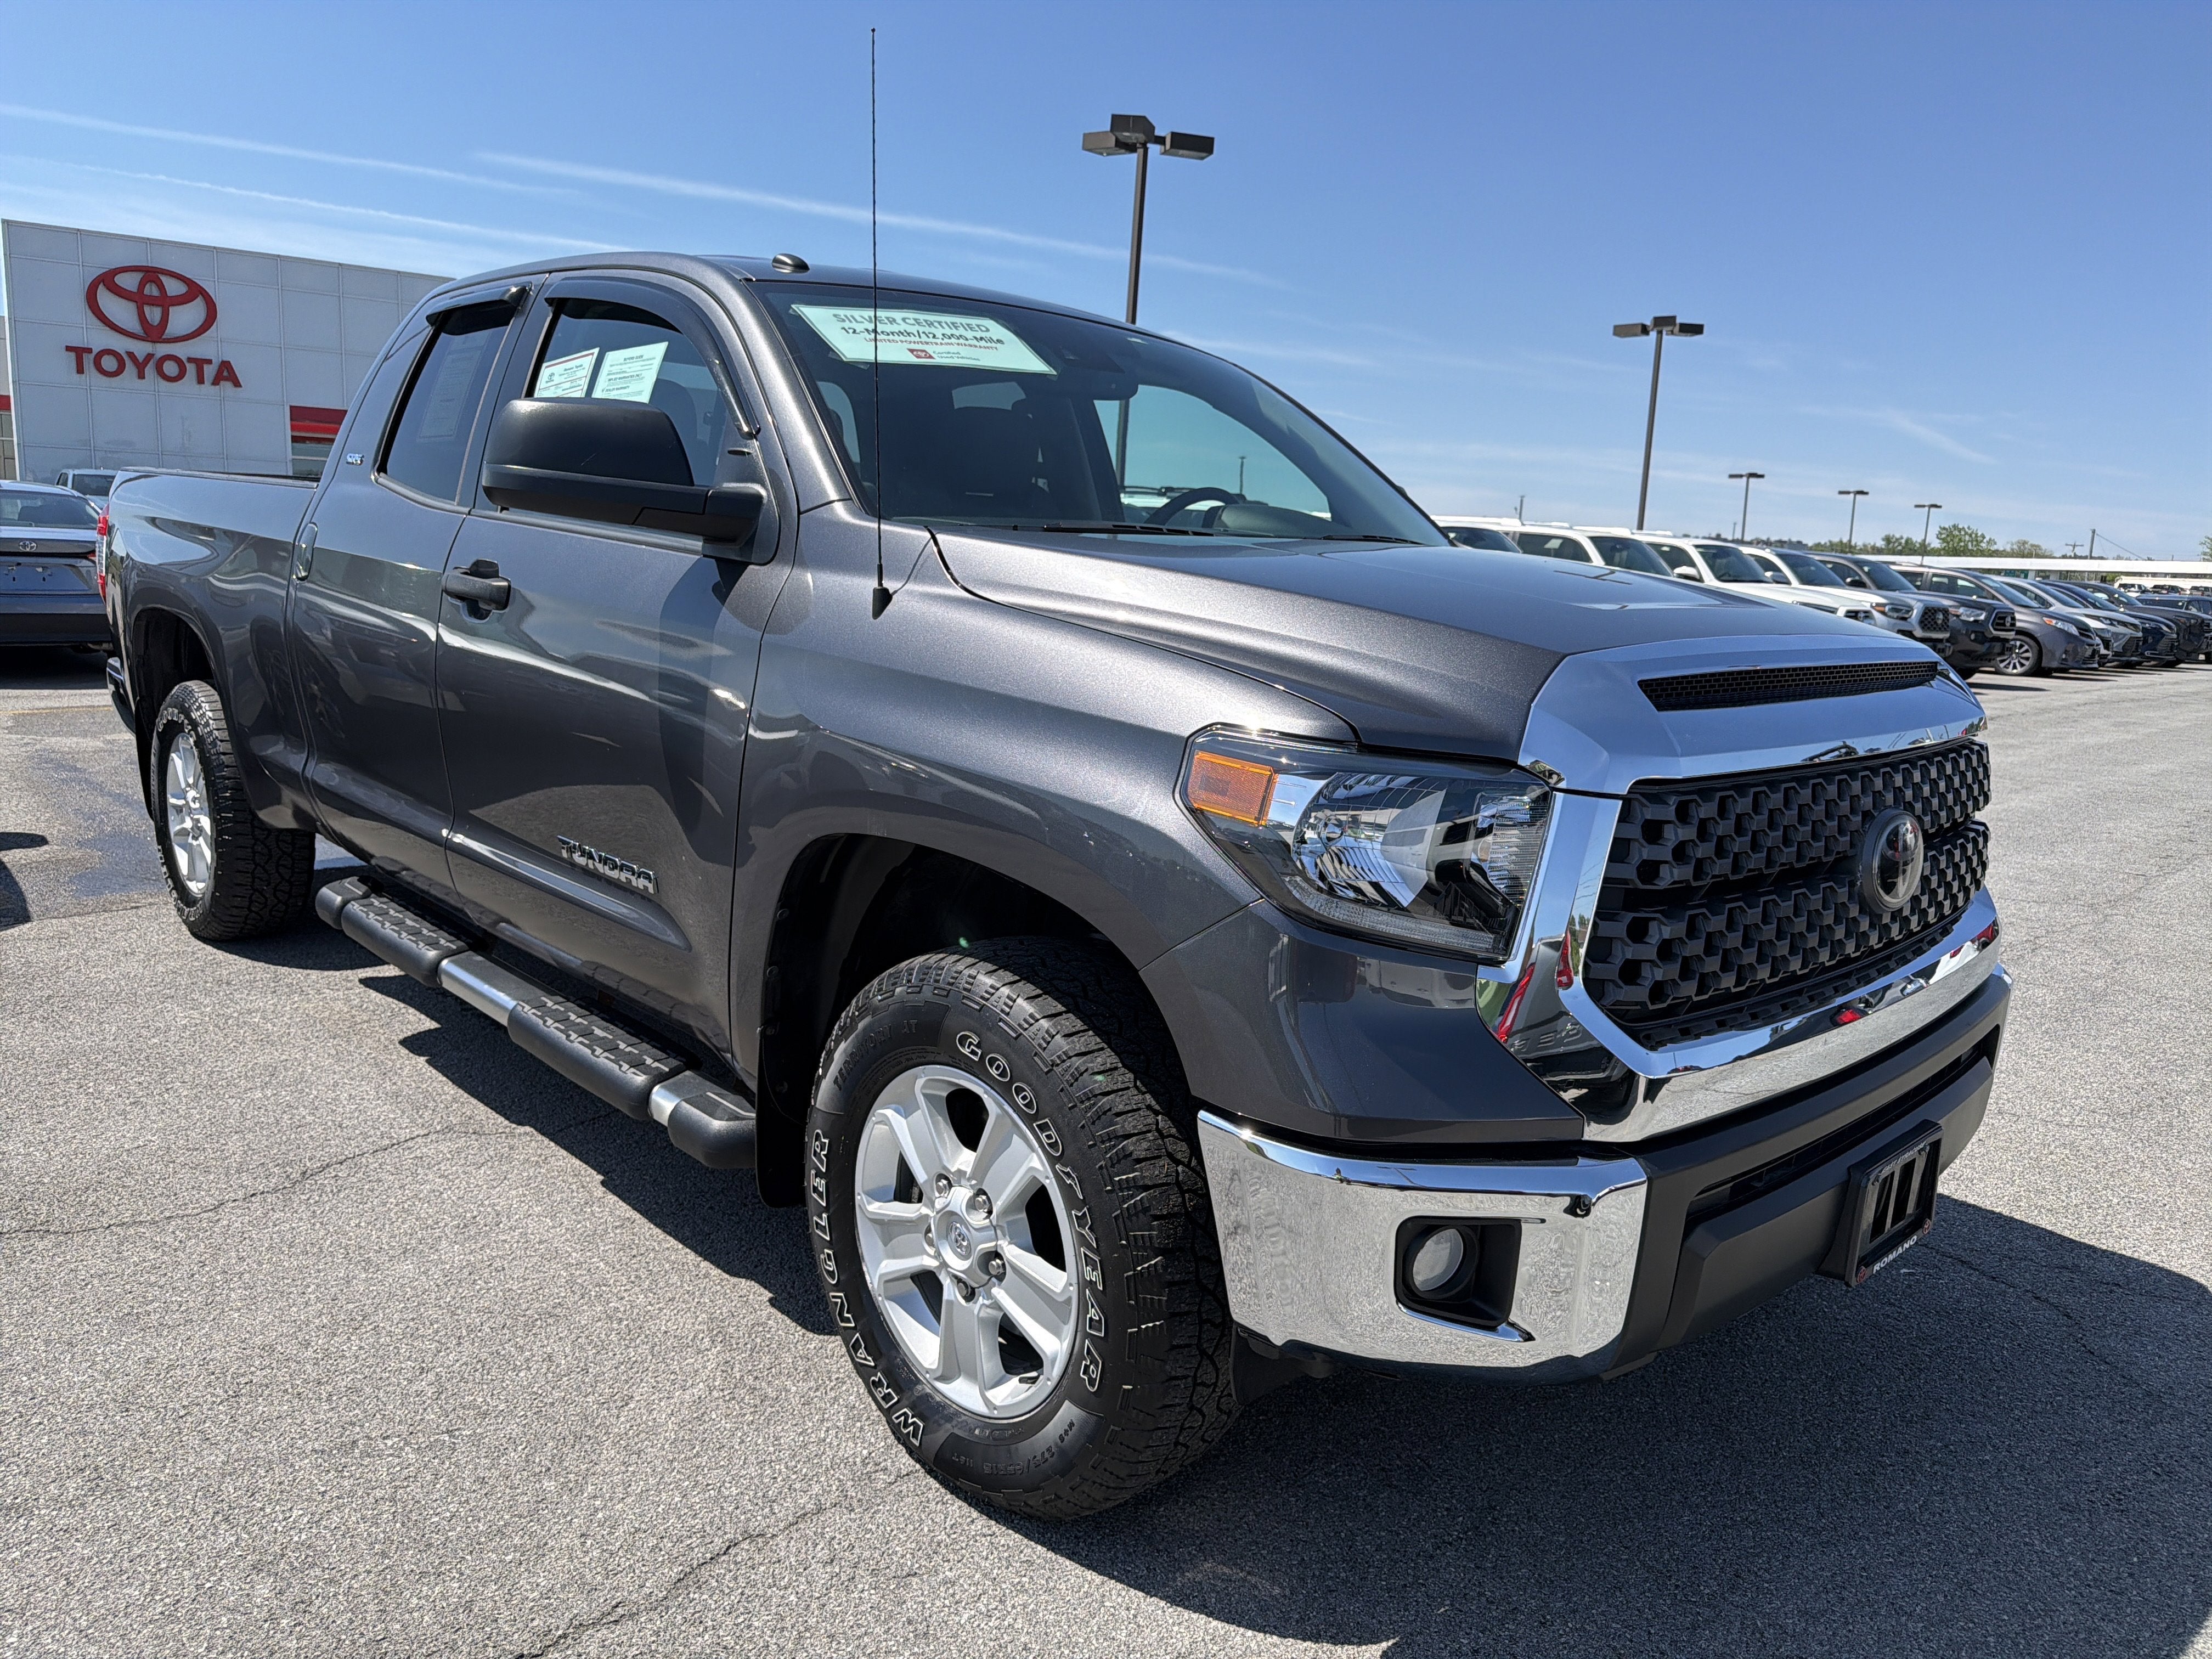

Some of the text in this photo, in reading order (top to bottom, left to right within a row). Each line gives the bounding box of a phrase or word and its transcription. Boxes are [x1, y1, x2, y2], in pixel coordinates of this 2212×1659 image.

[833, 314, 990, 332] SILVER CERTIFIED
[841, 326, 1005, 345] 12-Month/12,000-Mile
[955, 342, 998, 351] WARRANTY
[65, 346, 242, 388] TOYOTA
[556, 834, 659, 894] TUNDRA
[901, 1020, 918, 1034] AT
[956, 1031, 1104, 1392] GOODYEAR
[1873, 1235, 1917, 1274] ROMANO
[811, 1129, 923, 1447] WRANGLER
